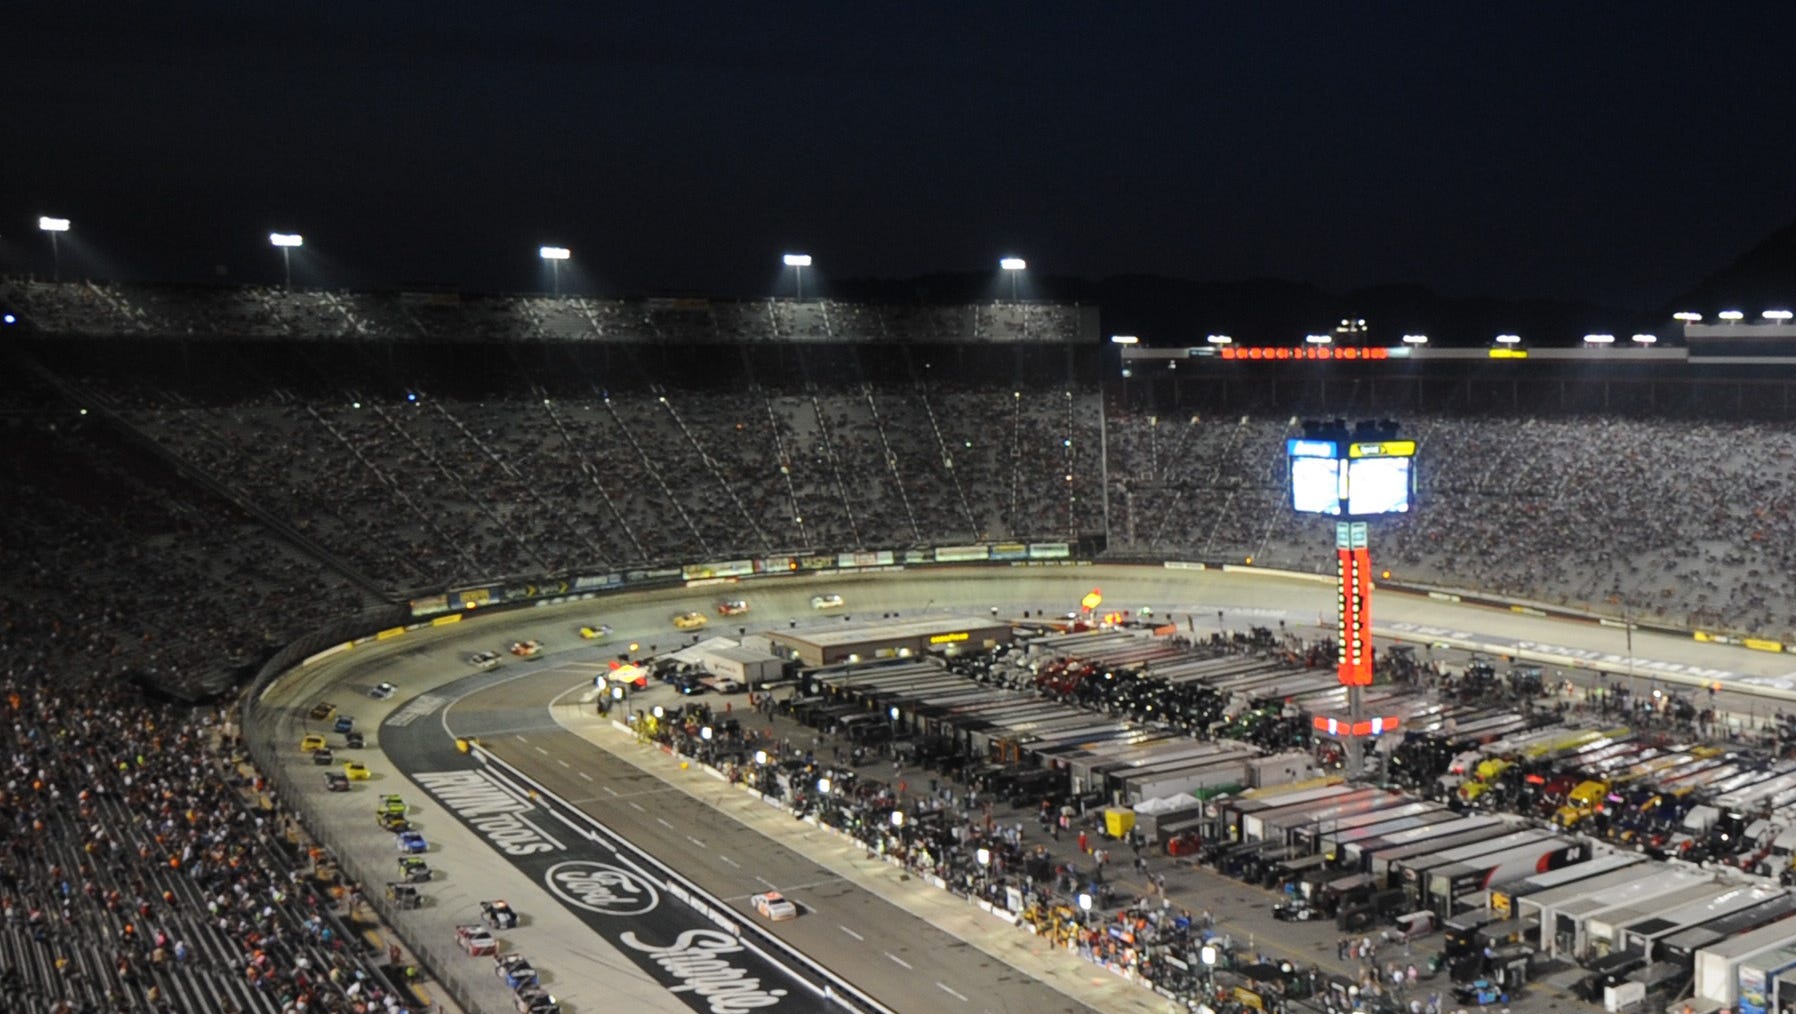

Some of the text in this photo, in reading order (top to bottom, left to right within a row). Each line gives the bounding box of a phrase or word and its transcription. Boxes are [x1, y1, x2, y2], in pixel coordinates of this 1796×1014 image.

[412, 769, 553, 856] IRWIN TOOLS
[555, 870, 643, 906] Ford
